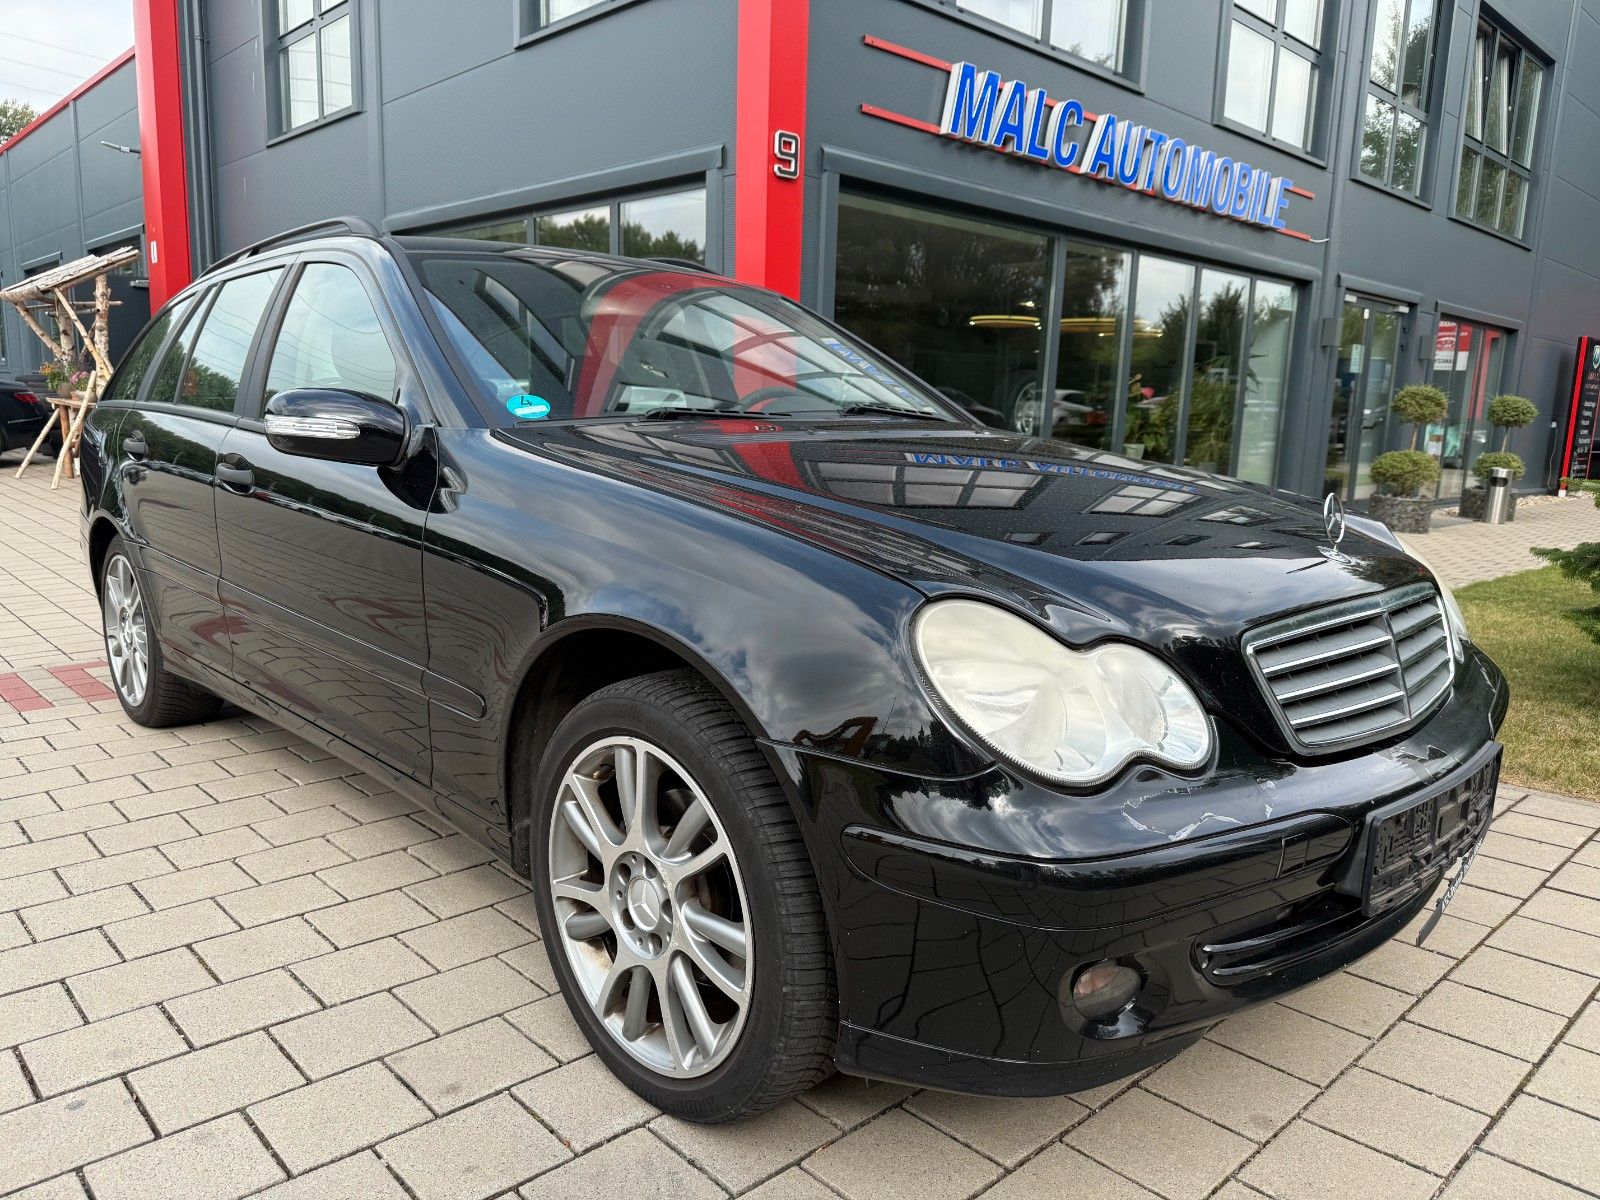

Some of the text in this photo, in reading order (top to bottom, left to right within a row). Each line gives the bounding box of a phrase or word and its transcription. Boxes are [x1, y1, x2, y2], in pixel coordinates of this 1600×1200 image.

[774, 129, 800, 179] 9
[942, 61, 1293, 230] MALC AUTOMOBILE
